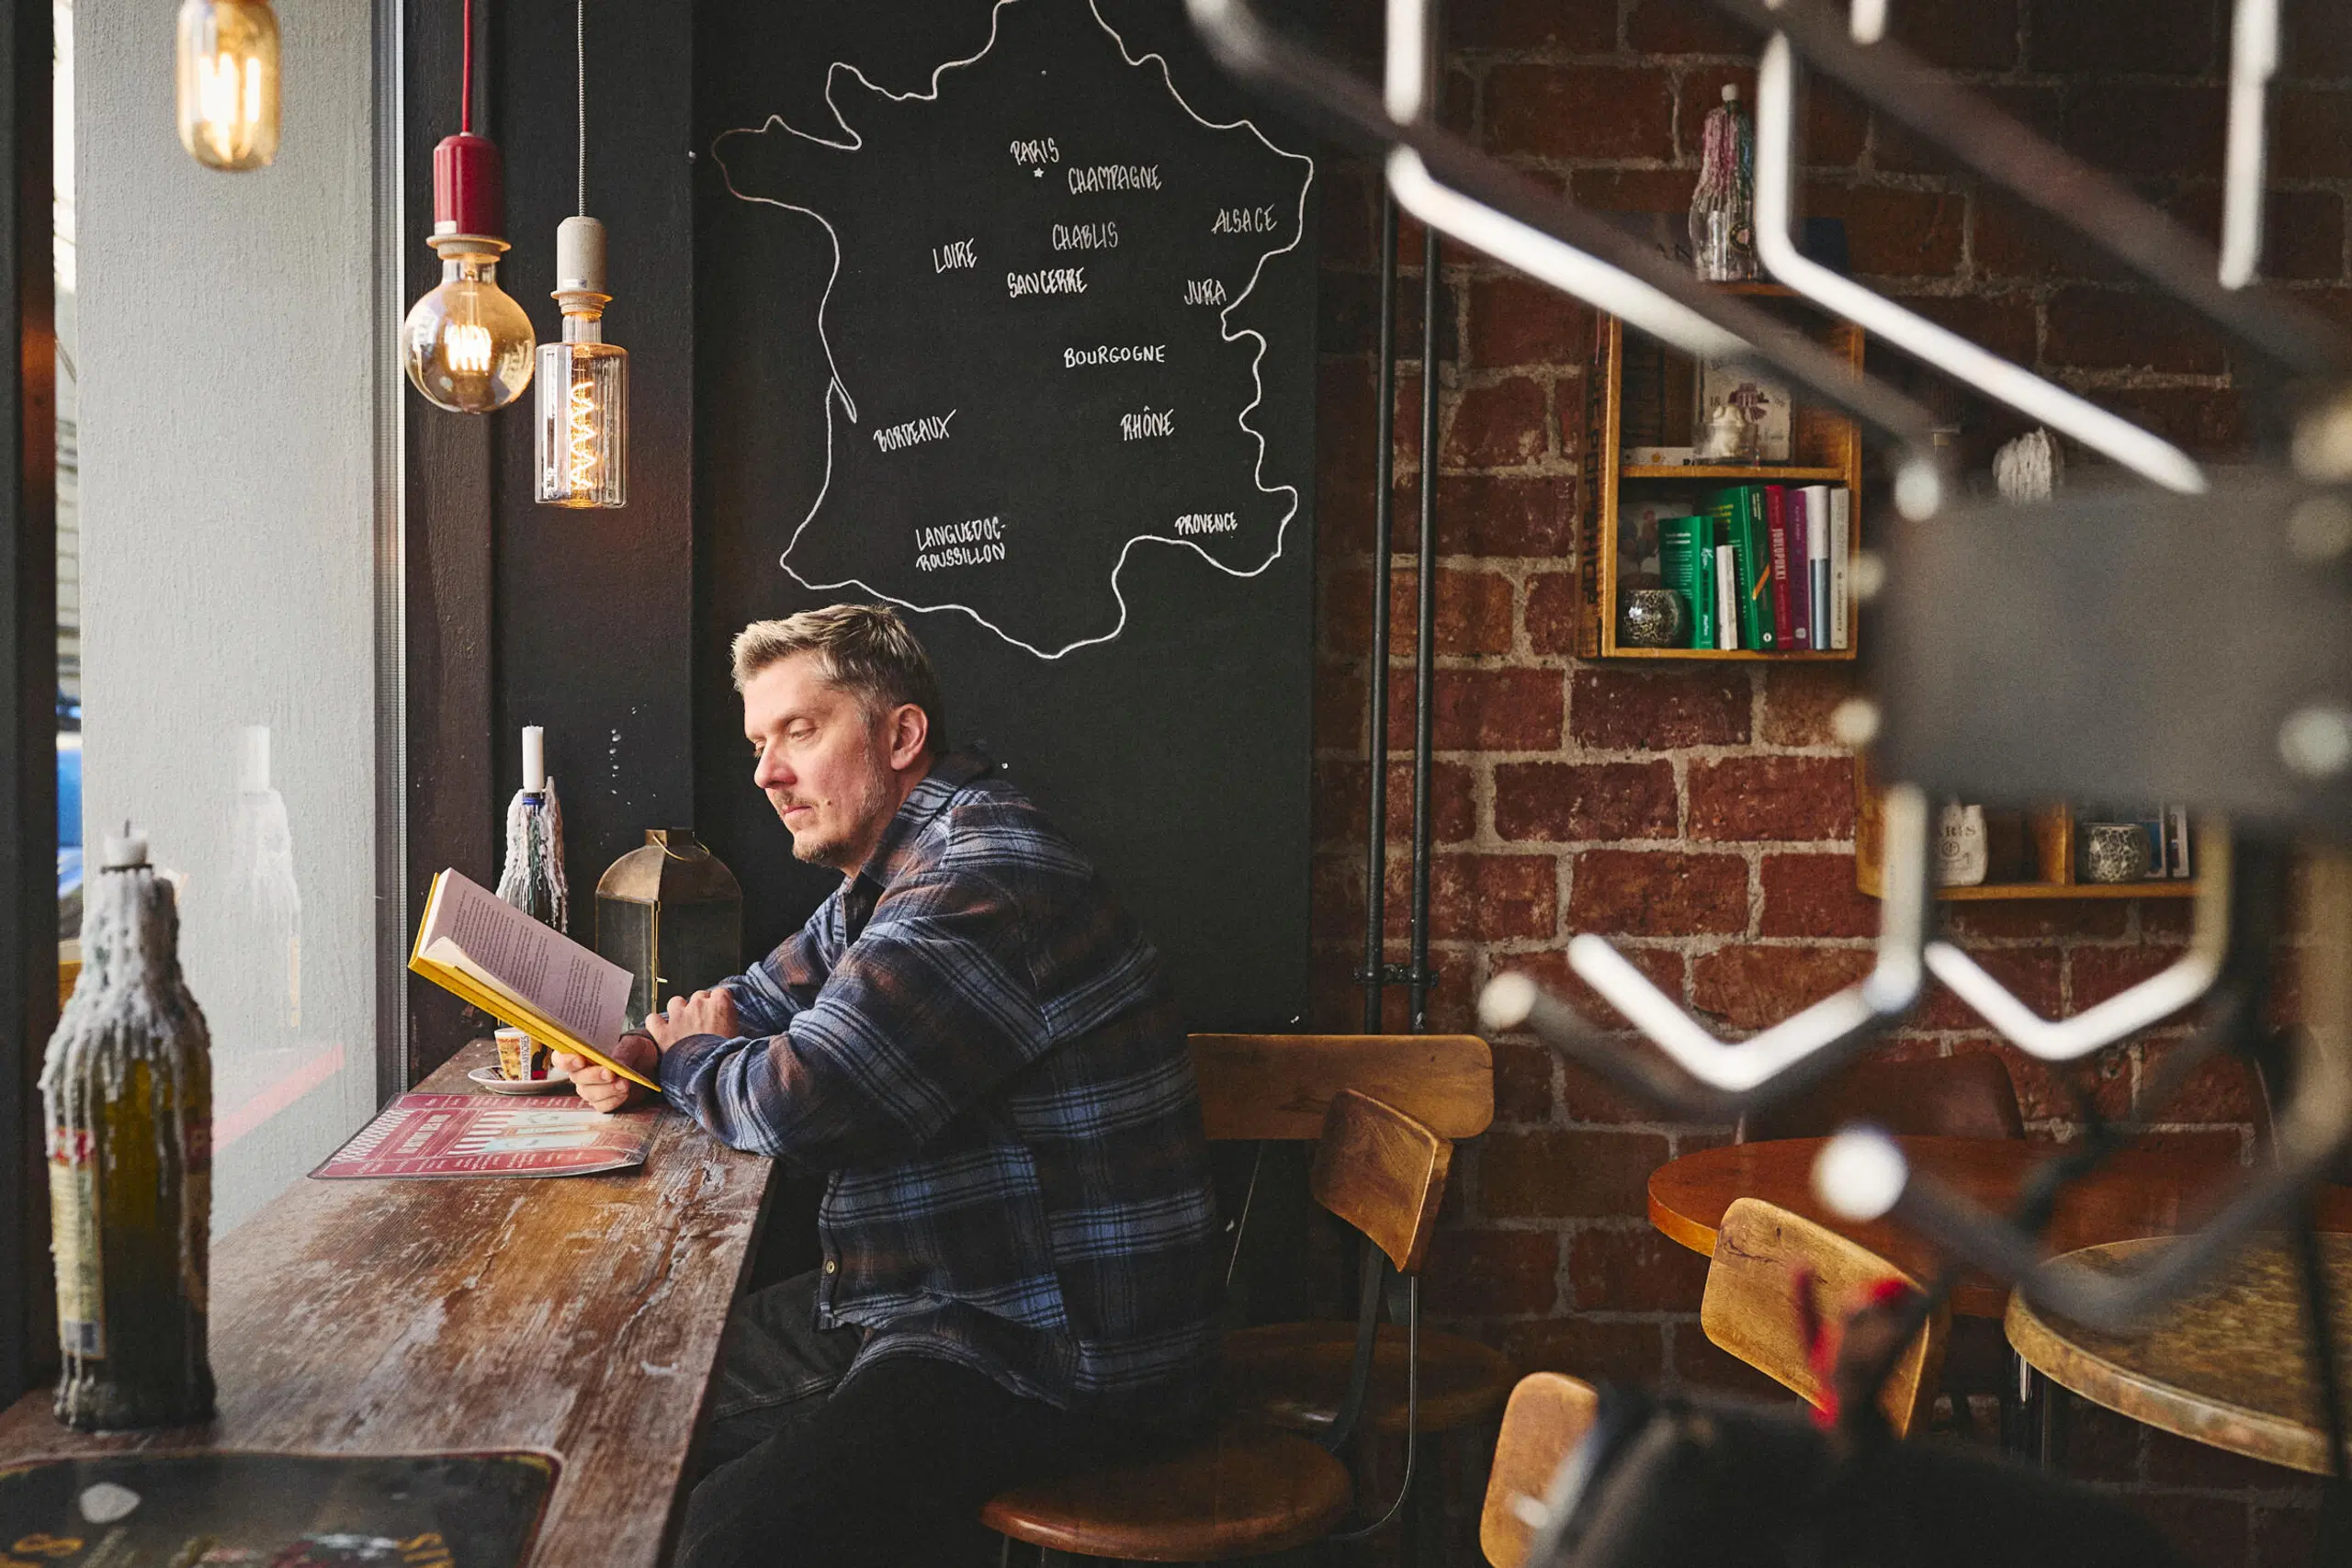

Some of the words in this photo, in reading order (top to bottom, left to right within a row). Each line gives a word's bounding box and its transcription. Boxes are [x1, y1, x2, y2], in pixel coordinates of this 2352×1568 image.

[1009, 137, 1059, 166] PARIS
[1068, 164, 1162, 196] CHAMPAGNE
[1211, 204, 1277, 234] ALSACE
[1052, 221, 1119, 251] CHABLIS
[933, 237, 978, 274] LOIRE
[1007, 266, 1088, 299] SANCERRE
[1183, 278, 1227, 306] JURA
[1063, 344, 1166, 368] BOURGOGNE
[873, 408, 957, 453] BORDEAUX
[1119, 405, 1175, 442] RHÔNE
[915, 515, 1007, 552] LANGUEDOC-
[1173, 511, 1238, 536] PROVENCE
[915, 541, 1006, 572] ROUSSILLON
